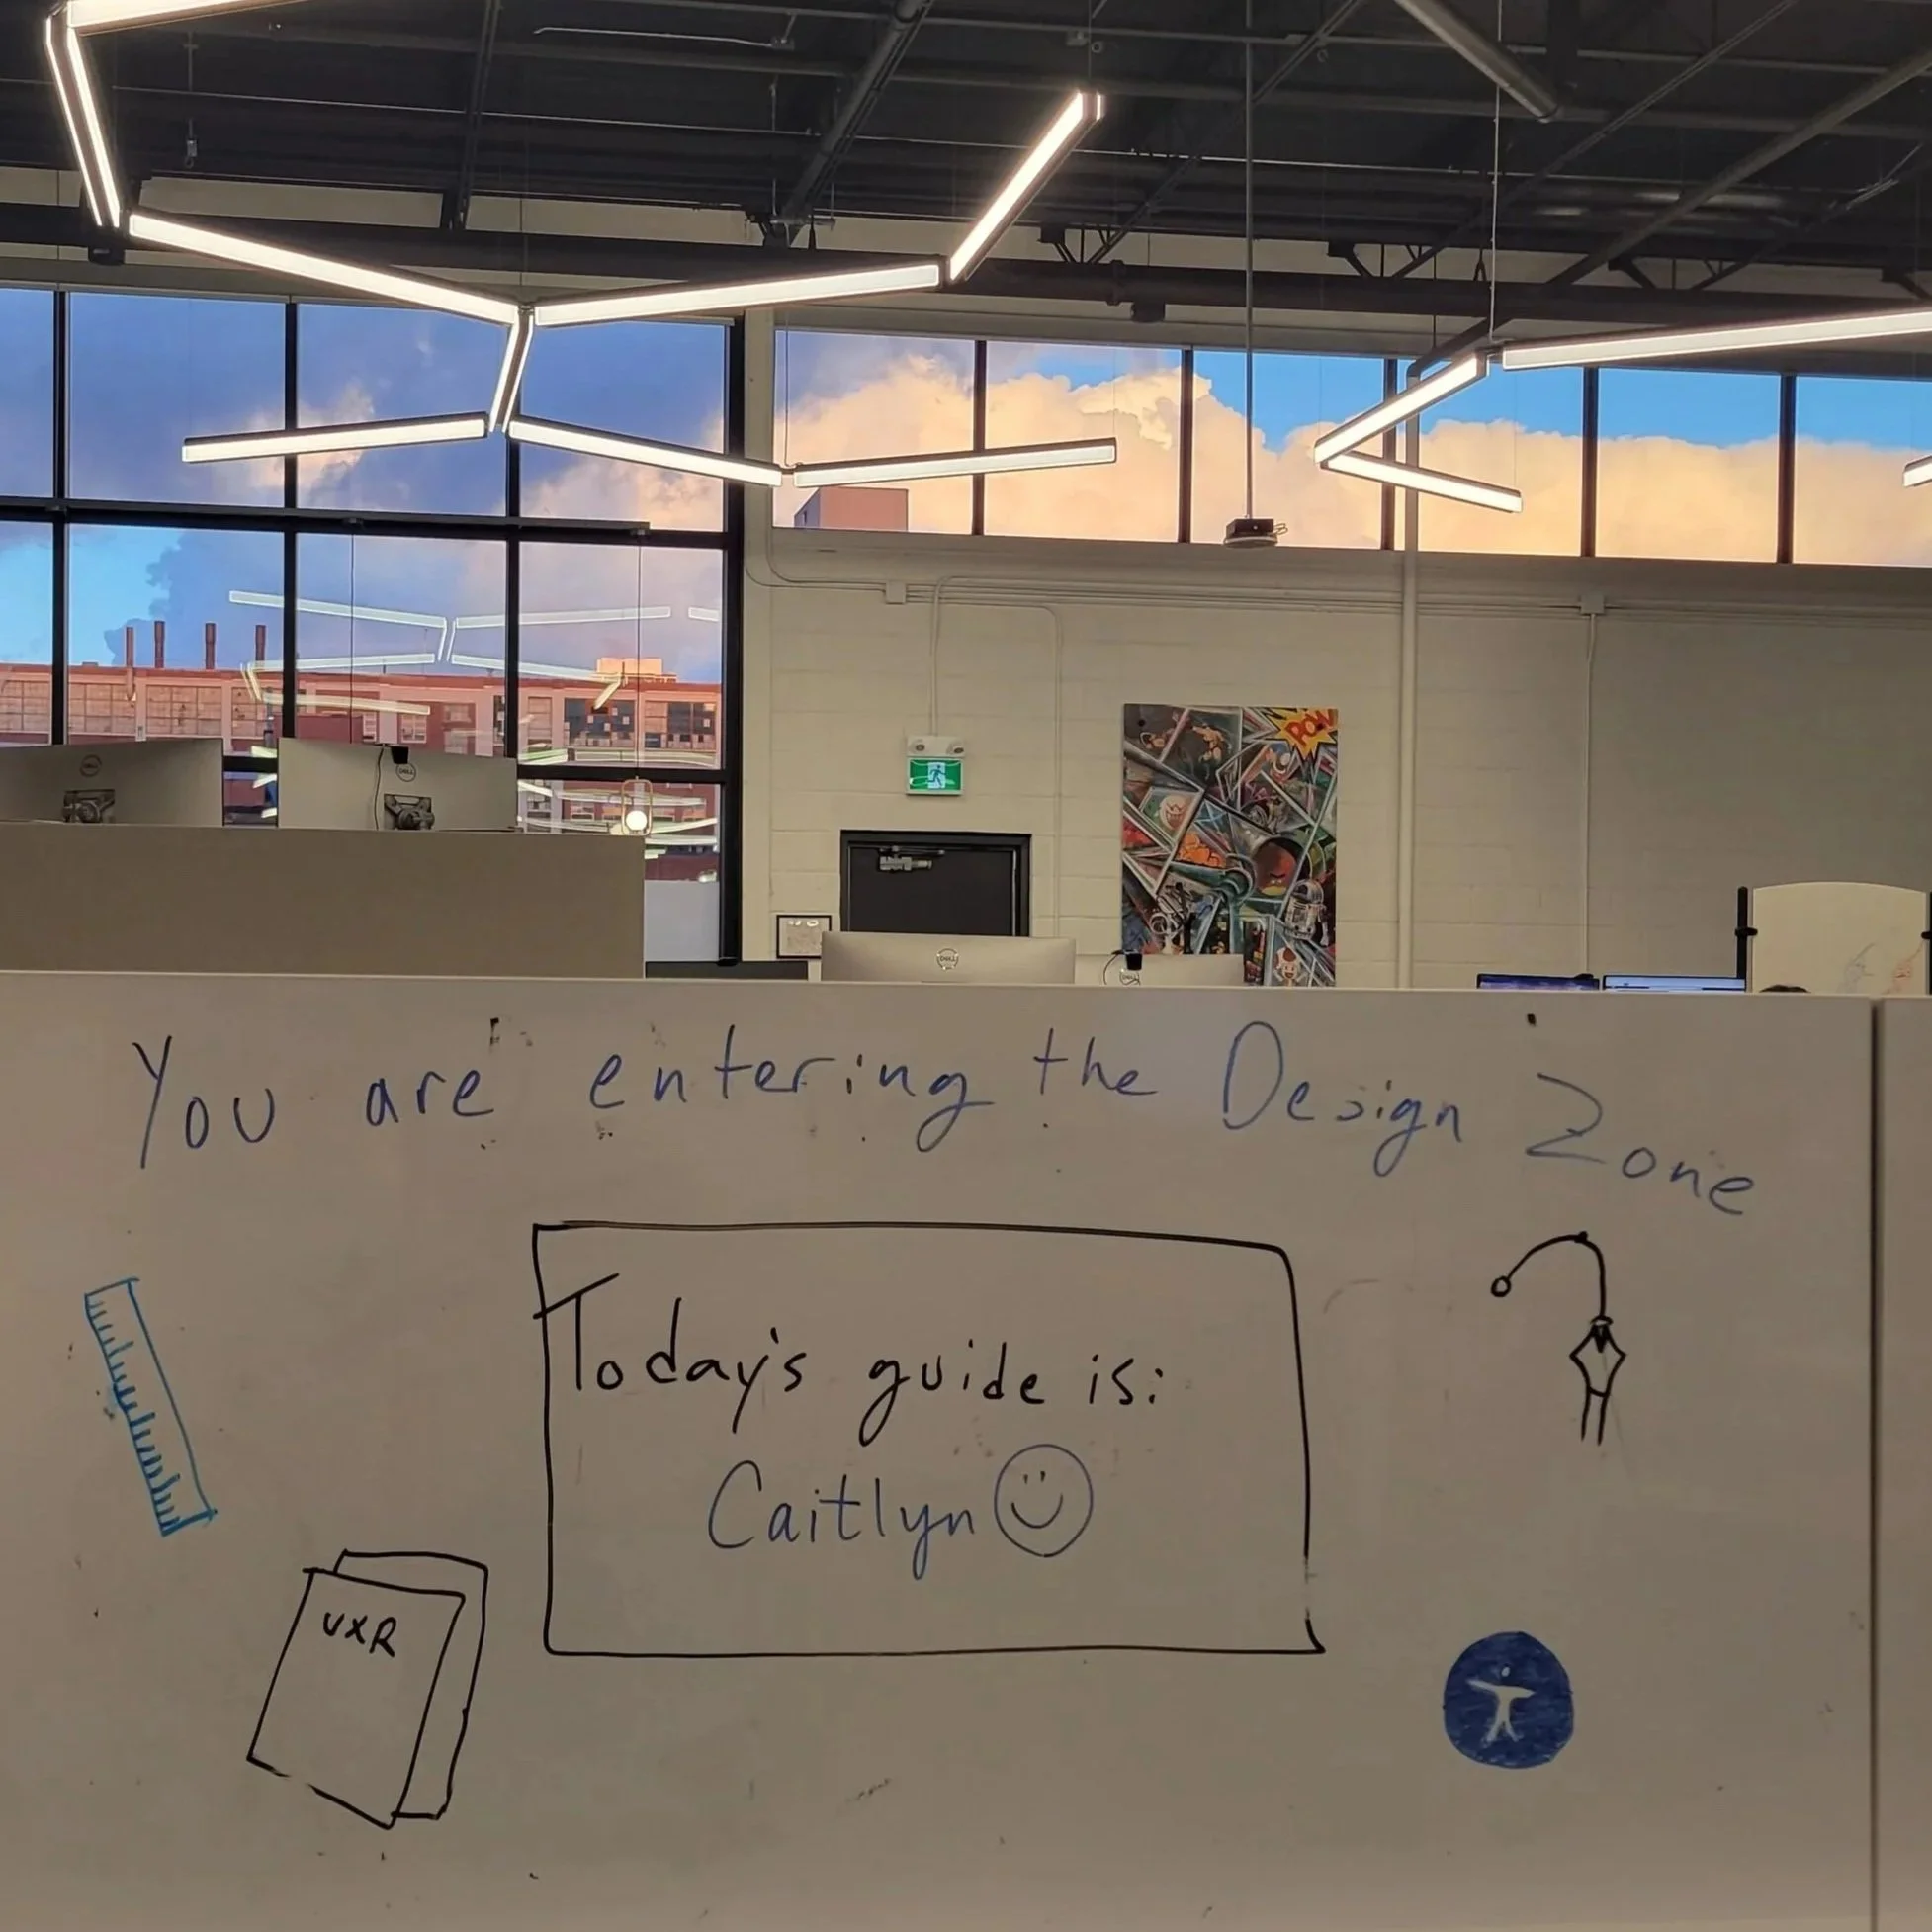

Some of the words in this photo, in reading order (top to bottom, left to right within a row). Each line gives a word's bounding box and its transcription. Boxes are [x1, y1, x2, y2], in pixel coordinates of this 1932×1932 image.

[131, 1034, 276, 1170] You
[365, 1069, 495, 1127] are
[589, 1023, 995, 1153] entering
[1032, 1027, 1158, 1097] the
[1222, 1020, 1462, 1178] Design
[1525, 1072, 1755, 1216] Zone
[532, 1272, 808, 1435] Today's
[858, 1338, 1046, 1448] guide
[1088, 1353, 1164, 1406] is:
[707, 1459, 975, 1582] Caitlyn
